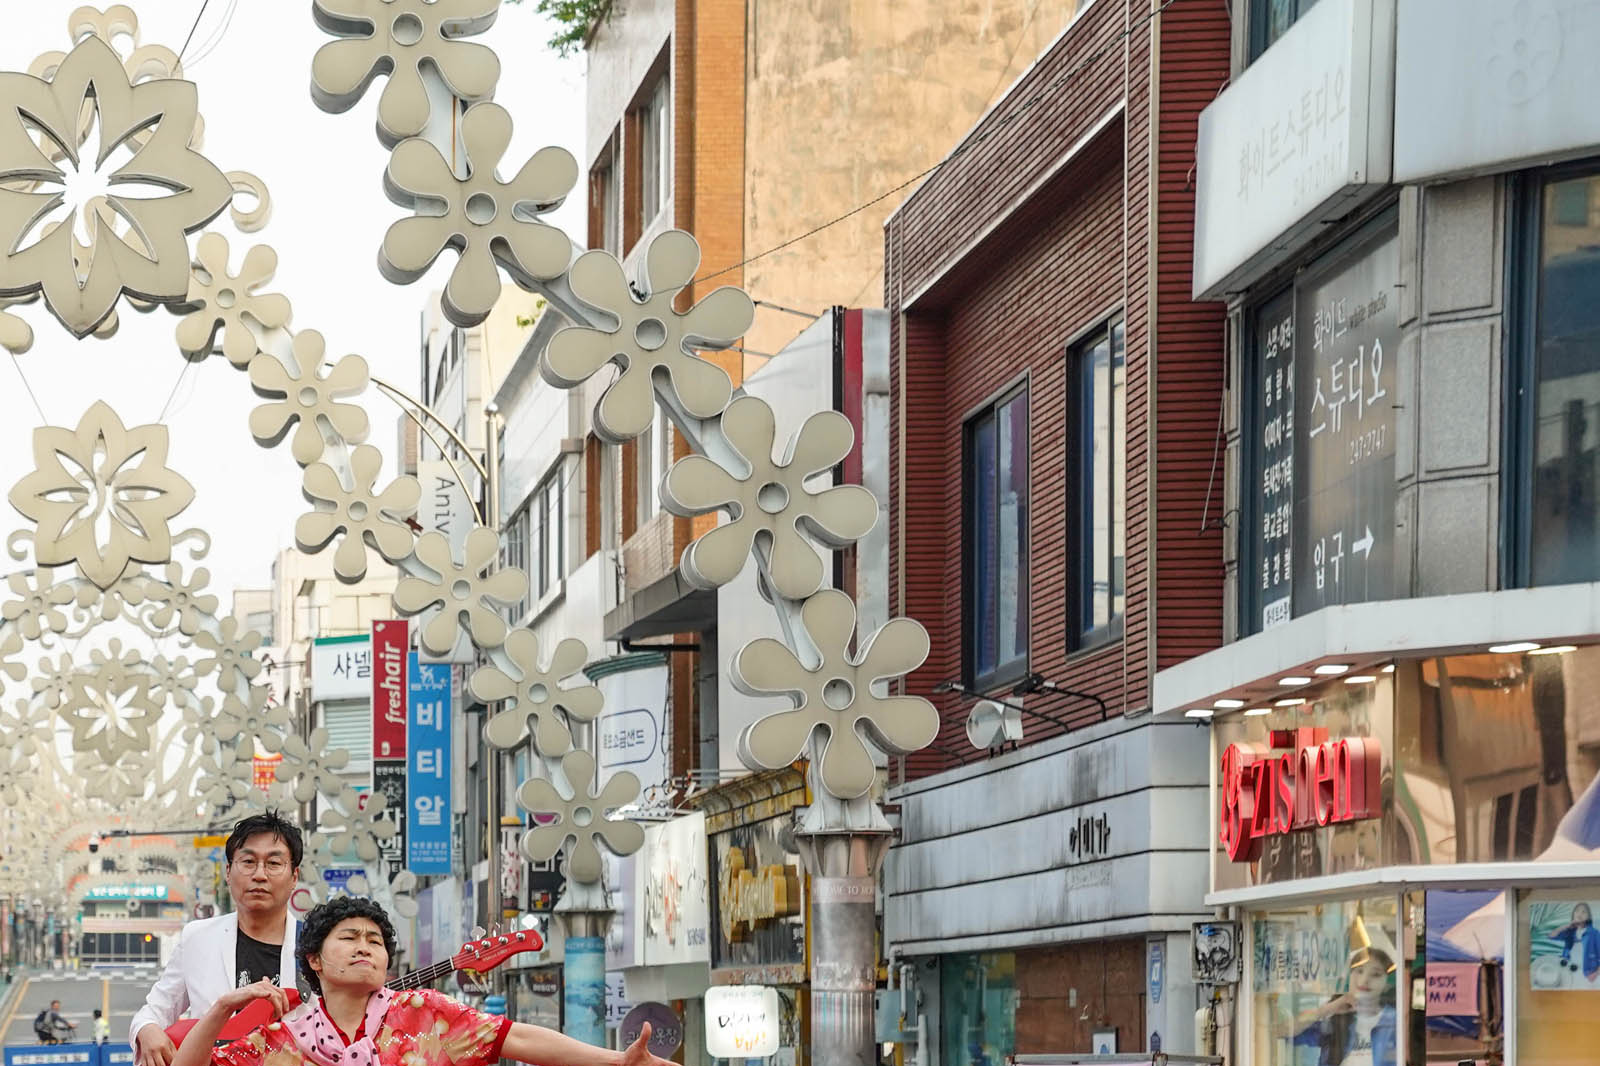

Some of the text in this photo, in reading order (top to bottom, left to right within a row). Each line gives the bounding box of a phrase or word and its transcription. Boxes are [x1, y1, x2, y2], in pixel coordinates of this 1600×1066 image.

[1313, 297, 1348, 353] 화이트
[1309, 337, 1387, 438] 스튜디오
[1313, 530, 1345, 590] 입구
[378, 640, 406, 725] freshair
